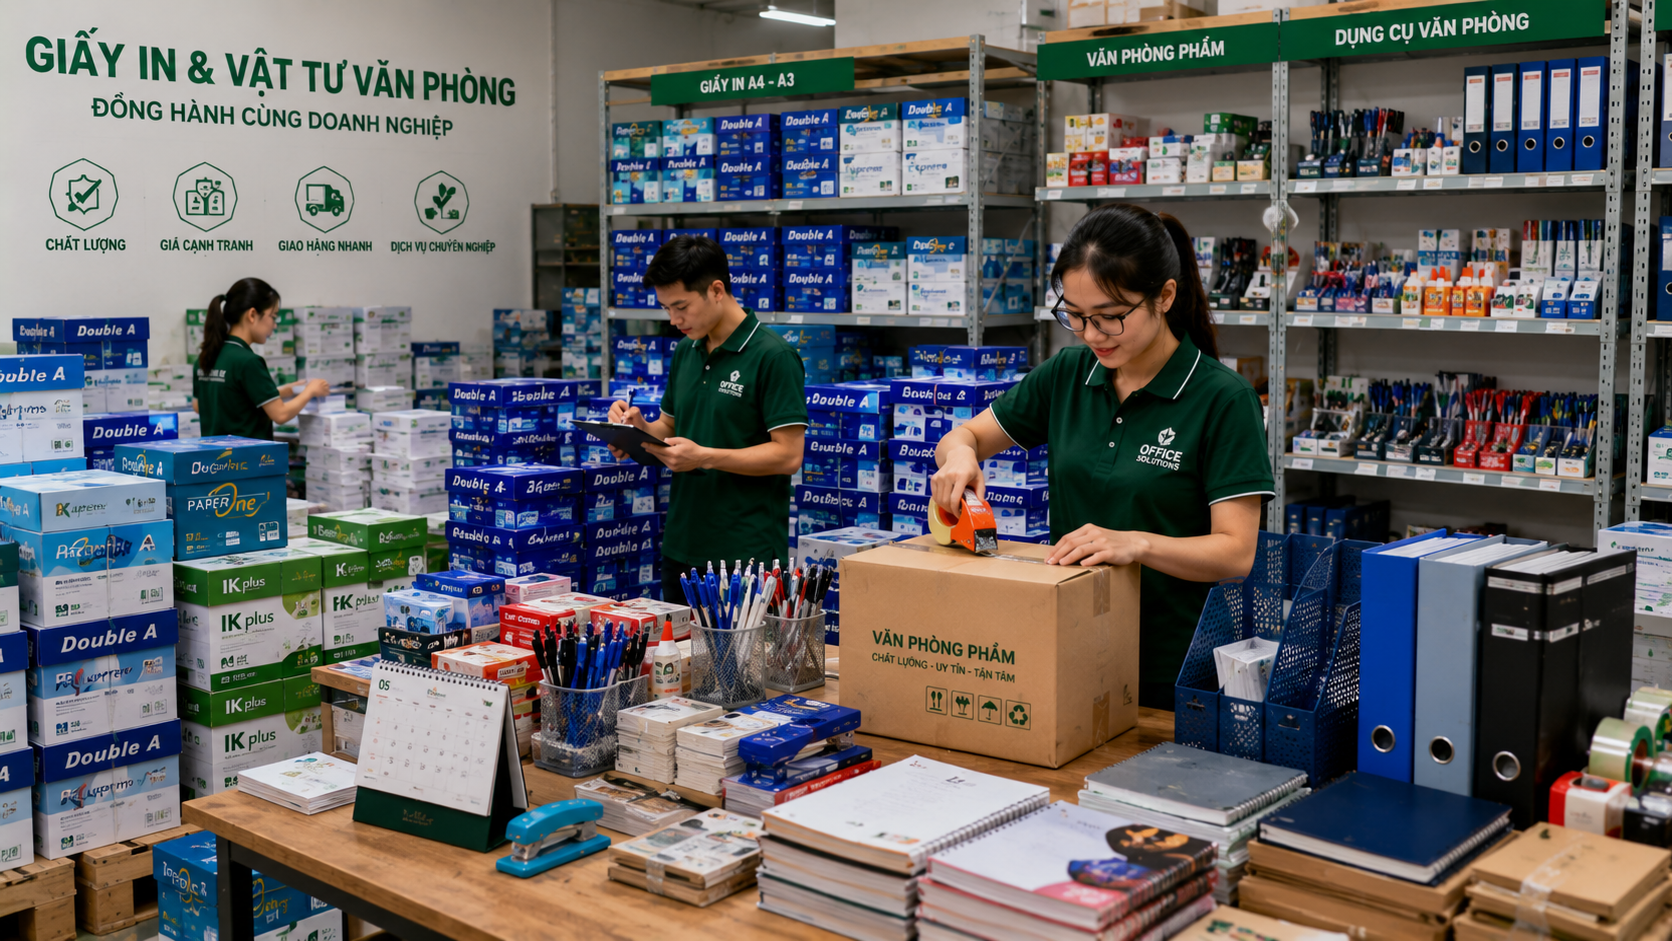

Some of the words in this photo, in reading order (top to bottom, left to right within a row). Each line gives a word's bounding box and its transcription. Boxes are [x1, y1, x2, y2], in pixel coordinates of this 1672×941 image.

[1335, 26, 1384, 49] DỤNG
[1389, 23, 1414, 44] CỤ
[1418, 16, 1456, 38] VĂN
[1462, 10, 1529, 35] PHÒNG
[1087, 47, 1117, 67] VĂN
[1121, 43, 1174, 64] PHÒNG
[25, 27, 125, 78] GIẤY
[139, 45, 176, 82] IN
[187, 50, 215, 85] &
[225, 47, 293, 97] VẬT
[302, 59, 347, 94] TƯ
[353, 59, 414, 99] VĂN
[423, 67, 516, 106] PHÒNG
[732, 77, 744, 91] IN
[748, 75, 765, 89] A4
[777, 72, 794, 87] A3
[91, 92, 163, 121] ĐỒNG
[170, 99, 234, 125] HÀNH
[241, 104, 302, 128] CÙNG
[308, 111, 380, 133] DOANH
[386, 115, 453, 140] NGHIỆP
[755, 117, 762, 128] A
[822, 112, 829, 123] A
[755, 161, 762, 172] A
[647, 232, 654, 243] A
[724, 231, 758, 242] Double
[759, 231, 767, 242] A
[788, 229, 824, 241] Double
[825, 229, 833, 240] A
[183, 239, 214, 254] CẠNH
[217, 239, 253, 251] TRANH
[278, 240, 304, 251] GIAO
[338, 240, 373, 251] NHANH
[391, 241, 412, 254] DỊCH
[415, 241, 427, 254] VỤ
[759, 274, 767, 284] A
[825, 273, 833, 284] A
[77, 324, 122, 336] Double
[127, 324, 135, 335] A
[0, 366, 46, 383] ouble
[53, 366, 66, 380] A
[489, 390, 496, 401] A
[812, 392, 855, 407] Double
[859, 395, 869, 408] A
[92, 424, 147, 439] Double
[153, 421, 164, 435] A
[1140, 444, 1183, 462] OFFICE
[1136, 455, 1180, 471] SOLUTIONS
[639, 466, 648, 480] A
[223, 577, 241, 594] IK
[243, 576, 265, 594] plus
[222, 612, 242, 632] IK
[245, 611, 274, 632] plus
[60, 627, 137, 653] Double
[143, 623, 158, 640] A
[908, 635, 963, 657] PHÒNG
[936, 662, 948, 673] UY
[226, 697, 242, 714] IK
[245, 696, 266, 712] plus
[225, 731, 245, 752] IK
[249, 729, 276, 751] plus
[65, 740, 140, 769] Double
[146, 734, 160, 751] A
